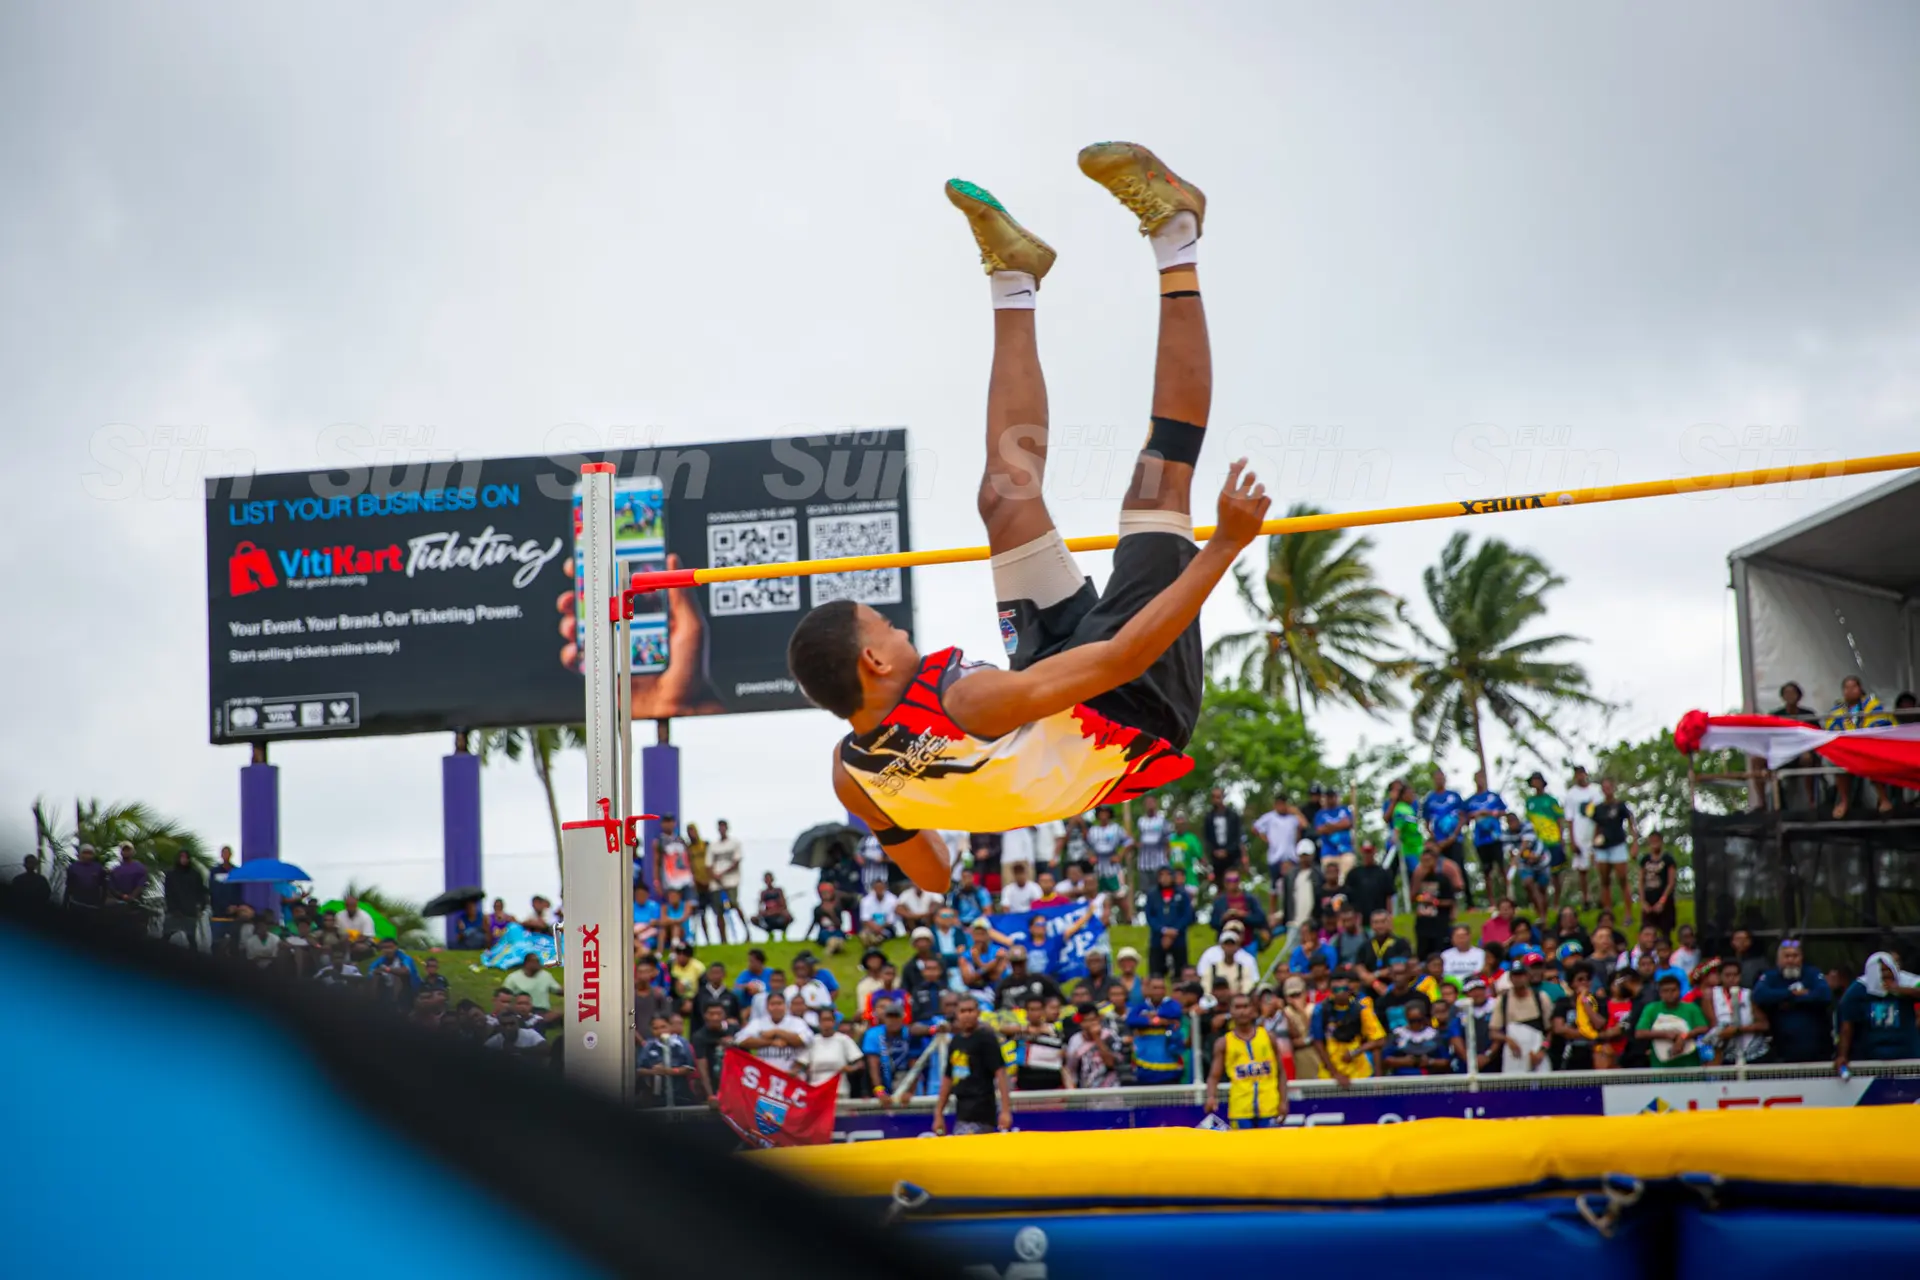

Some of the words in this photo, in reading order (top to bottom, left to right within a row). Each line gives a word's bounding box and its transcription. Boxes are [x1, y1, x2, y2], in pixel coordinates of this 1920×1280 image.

[229, 500, 278, 526] LIST
[283, 496, 352, 521] YOUR
[357, 487, 477, 516] BUSINESS
[481, 484, 520, 507] ON
[278, 543, 404, 578] VitiKart
[405, 525, 563, 589] Ticketing
[229, 621, 260, 637] Your
[261, 618, 306, 636] Event.
[306, 616, 338, 632] Your
[338, 613, 382, 630] Brand.
[383, 611, 409, 627] Our
[409, 607, 475, 625] Ticketing
[475, 604, 523, 621] Power.
[229, 649, 257, 663] Start
[257, 647, 293, 662] selling
[294, 644, 329, 659] tickets
[330, 642, 363, 656] online
[735, 679, 782, 697] powered
[782, 677, 796, 694] by
[880, 735, 949, 797] COLLEGE
[577, 923, 599, 1022] Vinex
